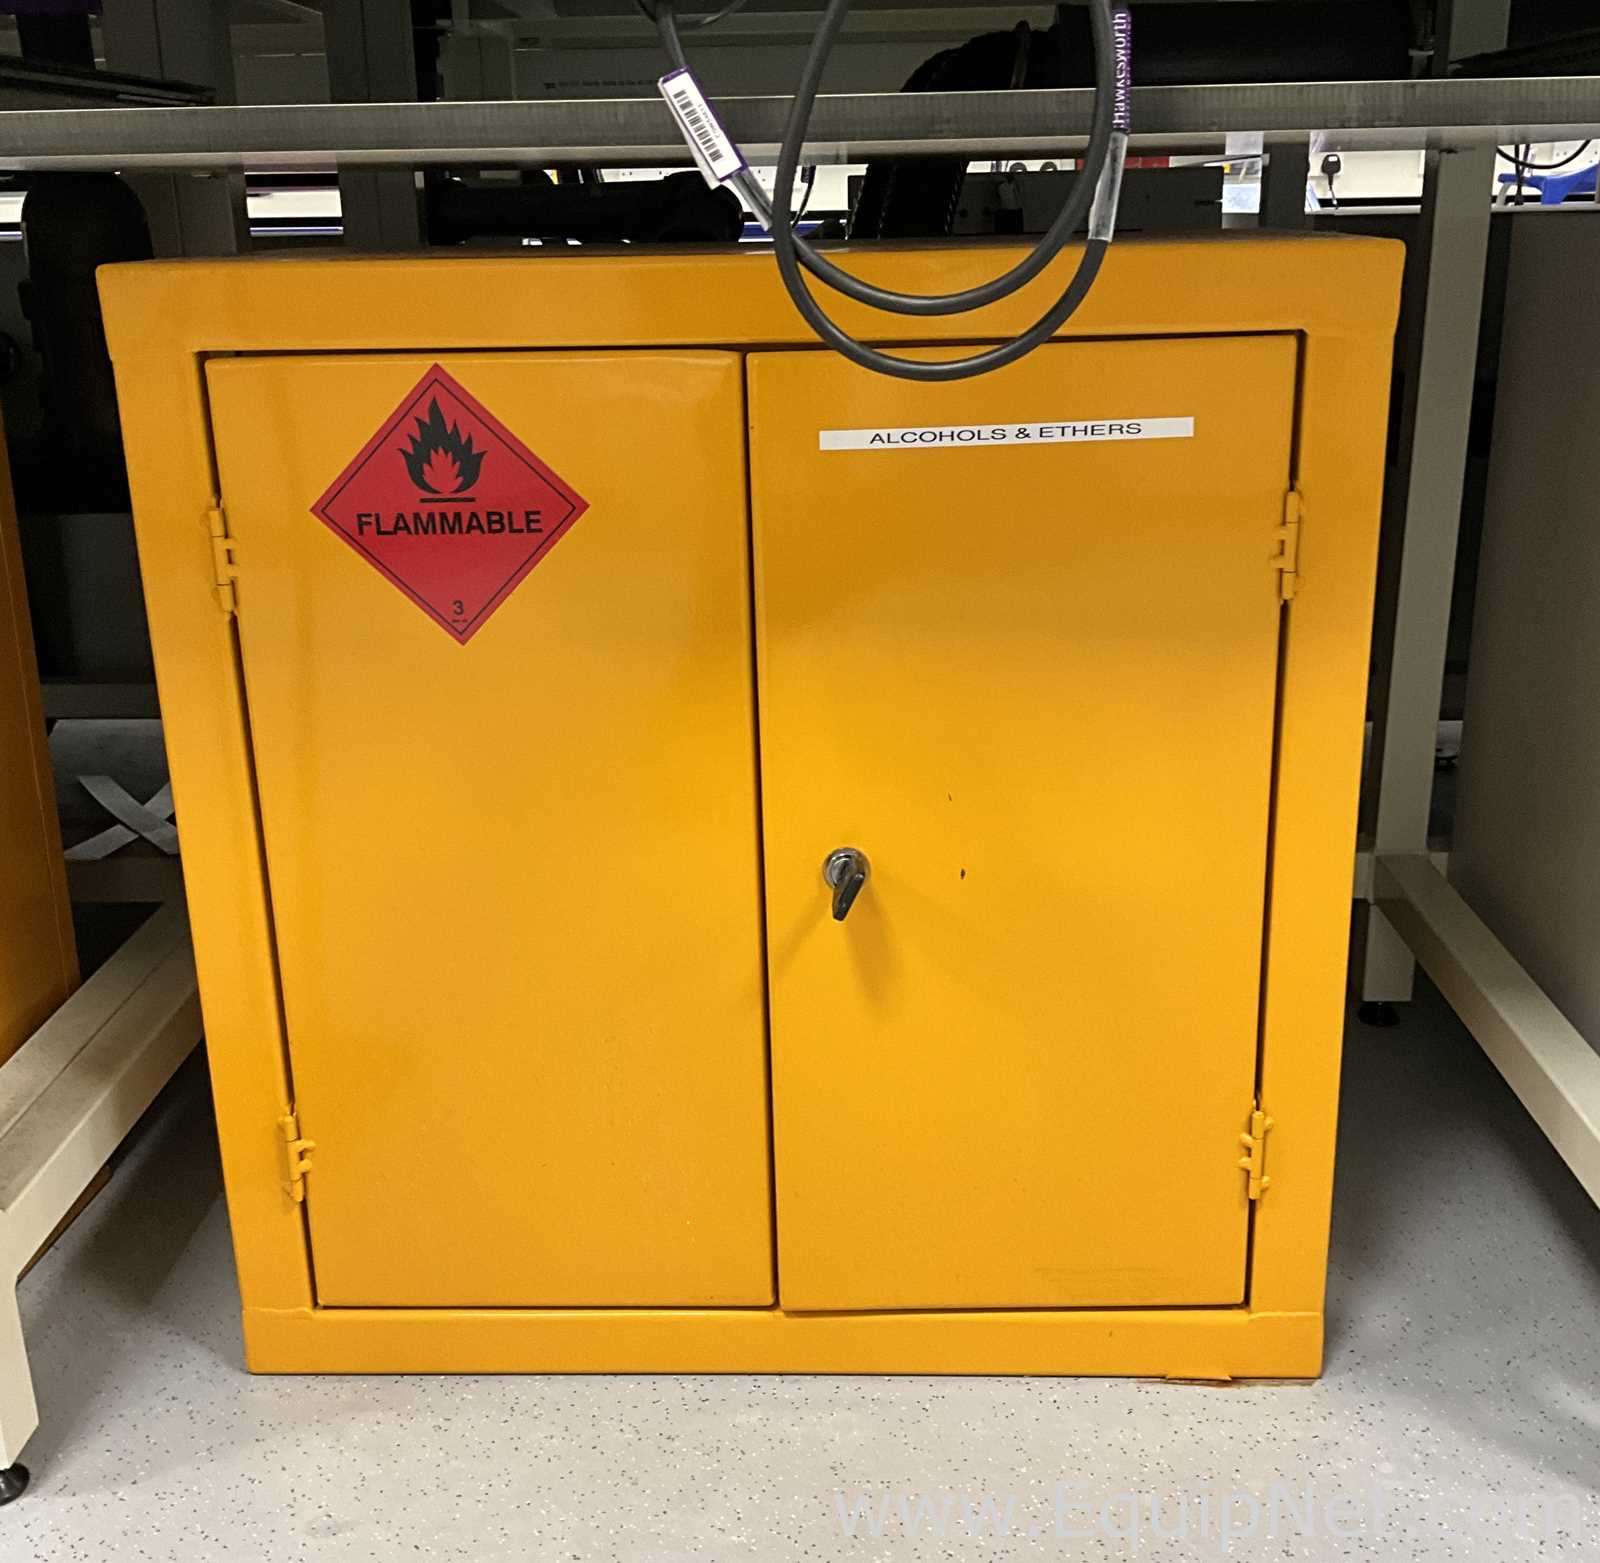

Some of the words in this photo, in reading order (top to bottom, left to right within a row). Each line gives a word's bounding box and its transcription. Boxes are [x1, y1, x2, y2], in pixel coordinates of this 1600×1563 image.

[869, 427, 1007, 445] ALCOHOLS
[1014, 426, 1032, 440] &
[1038, 422, 1143, 438] ETHERS
[355, 510, 543, 537] FLAMMABLE
[453, 599, 465, 617] 3
